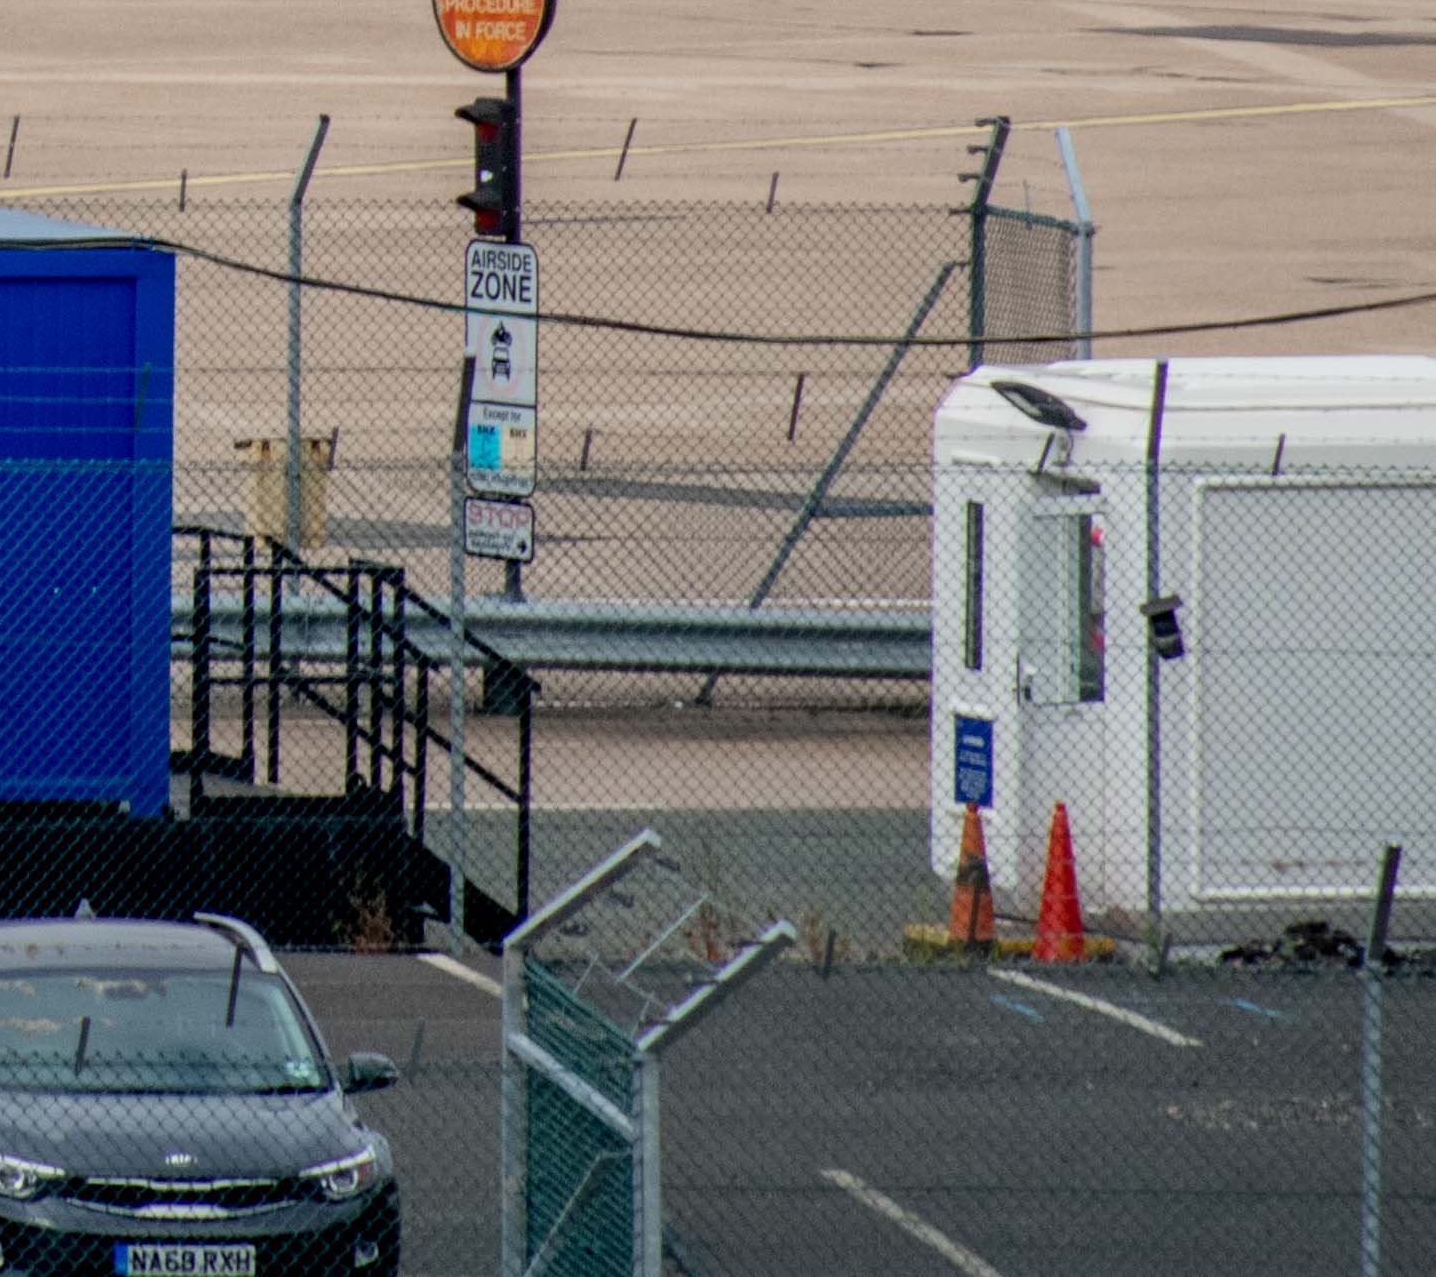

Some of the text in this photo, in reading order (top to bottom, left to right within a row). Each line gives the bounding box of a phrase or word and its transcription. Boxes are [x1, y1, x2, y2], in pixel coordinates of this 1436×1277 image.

[455, 21, 526, 41] IN FORCE
[472, 249, 532, 273] AIRSIDE
[470, 271, 532, 304] ZONE
[204, 1250, 250, 1272] RXH
